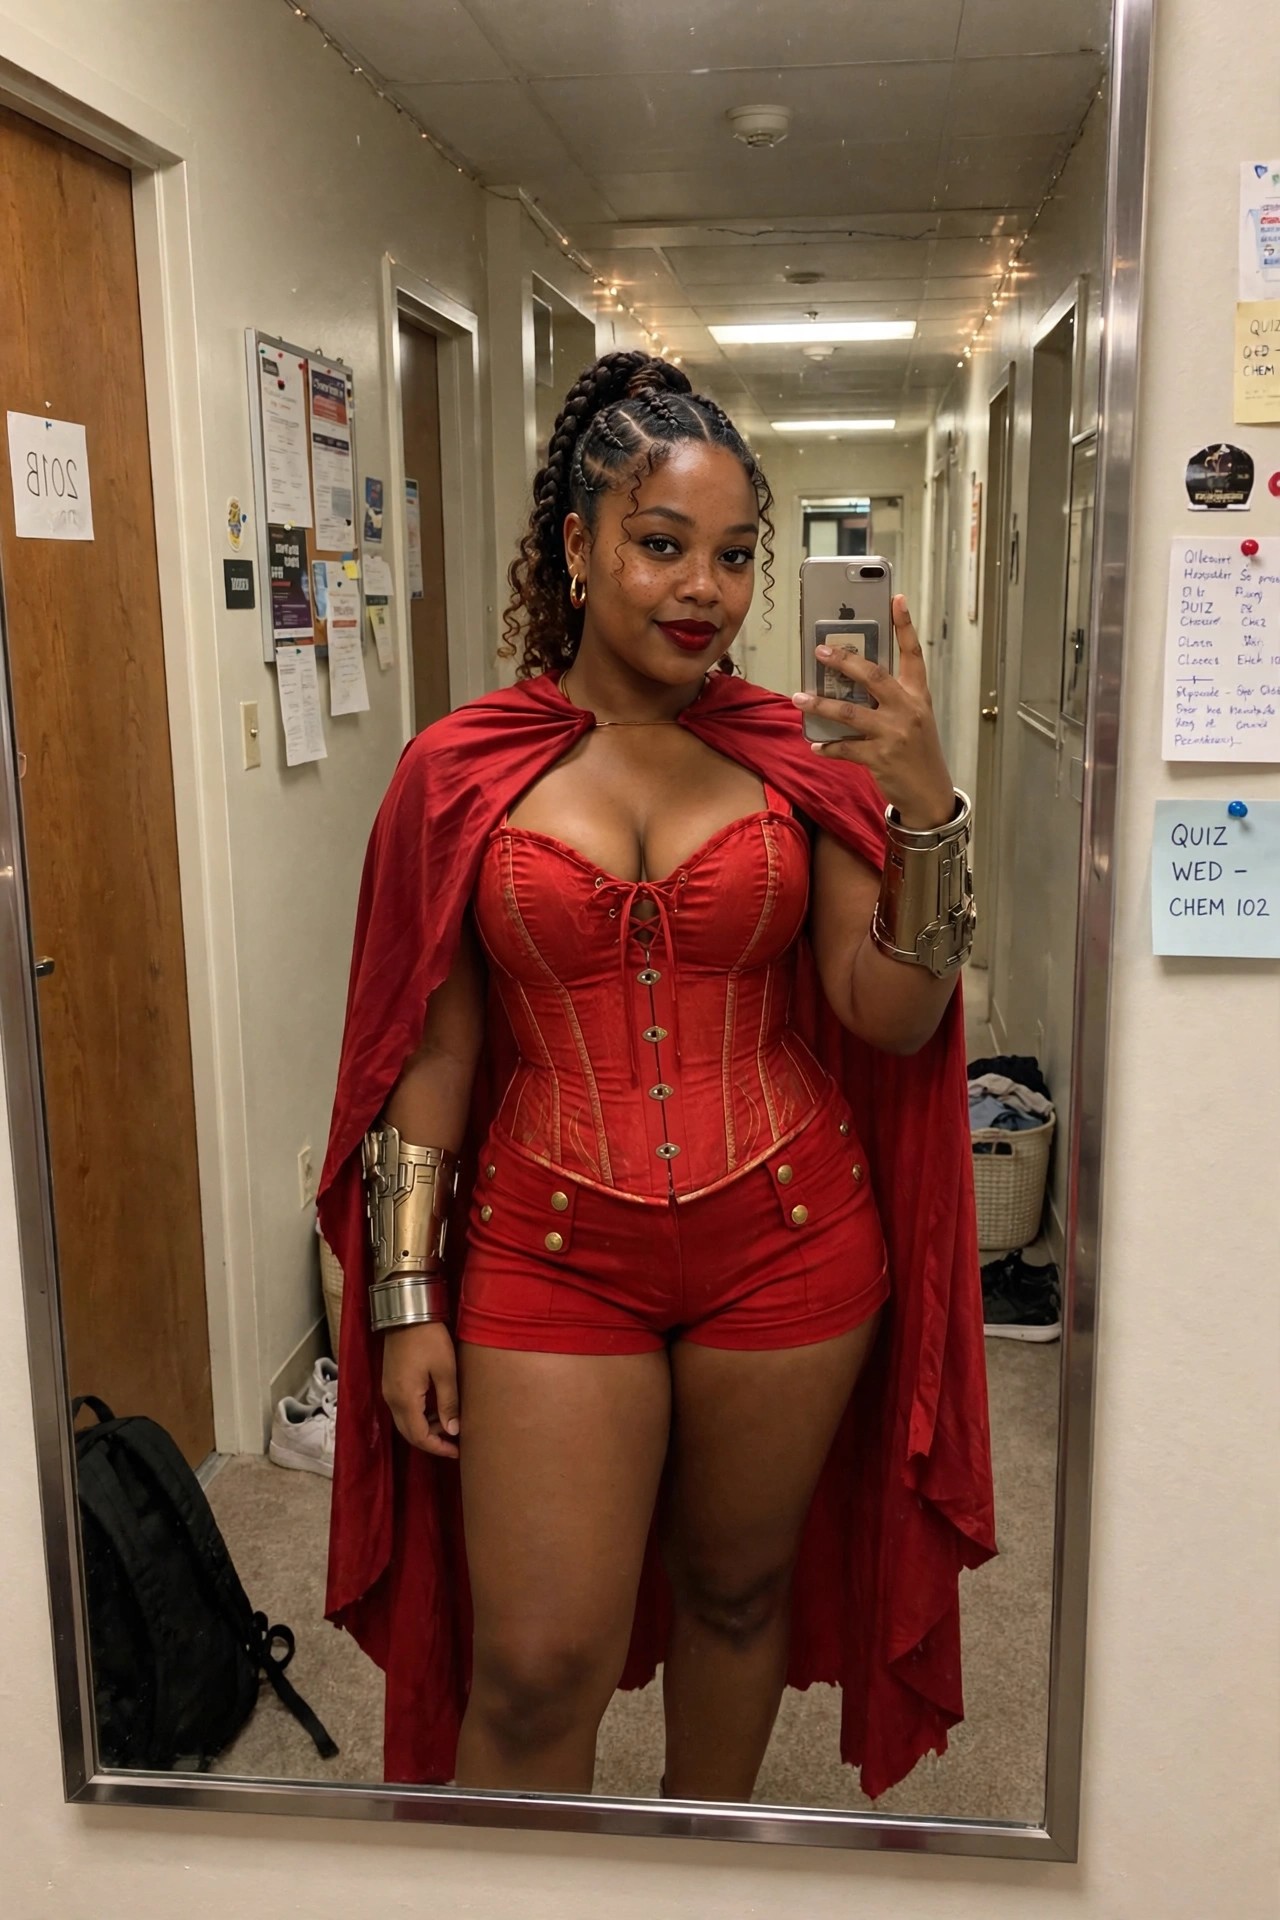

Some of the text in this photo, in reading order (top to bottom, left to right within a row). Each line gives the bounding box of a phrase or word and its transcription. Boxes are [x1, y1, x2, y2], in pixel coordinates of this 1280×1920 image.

[1243, 365, 1275, 376] CHEM
[1171, 823, 1228, 848] QUIZ
[1172, 861, 1222, 881] WED
[1169, 897, 1270, 916] CHEM 102
